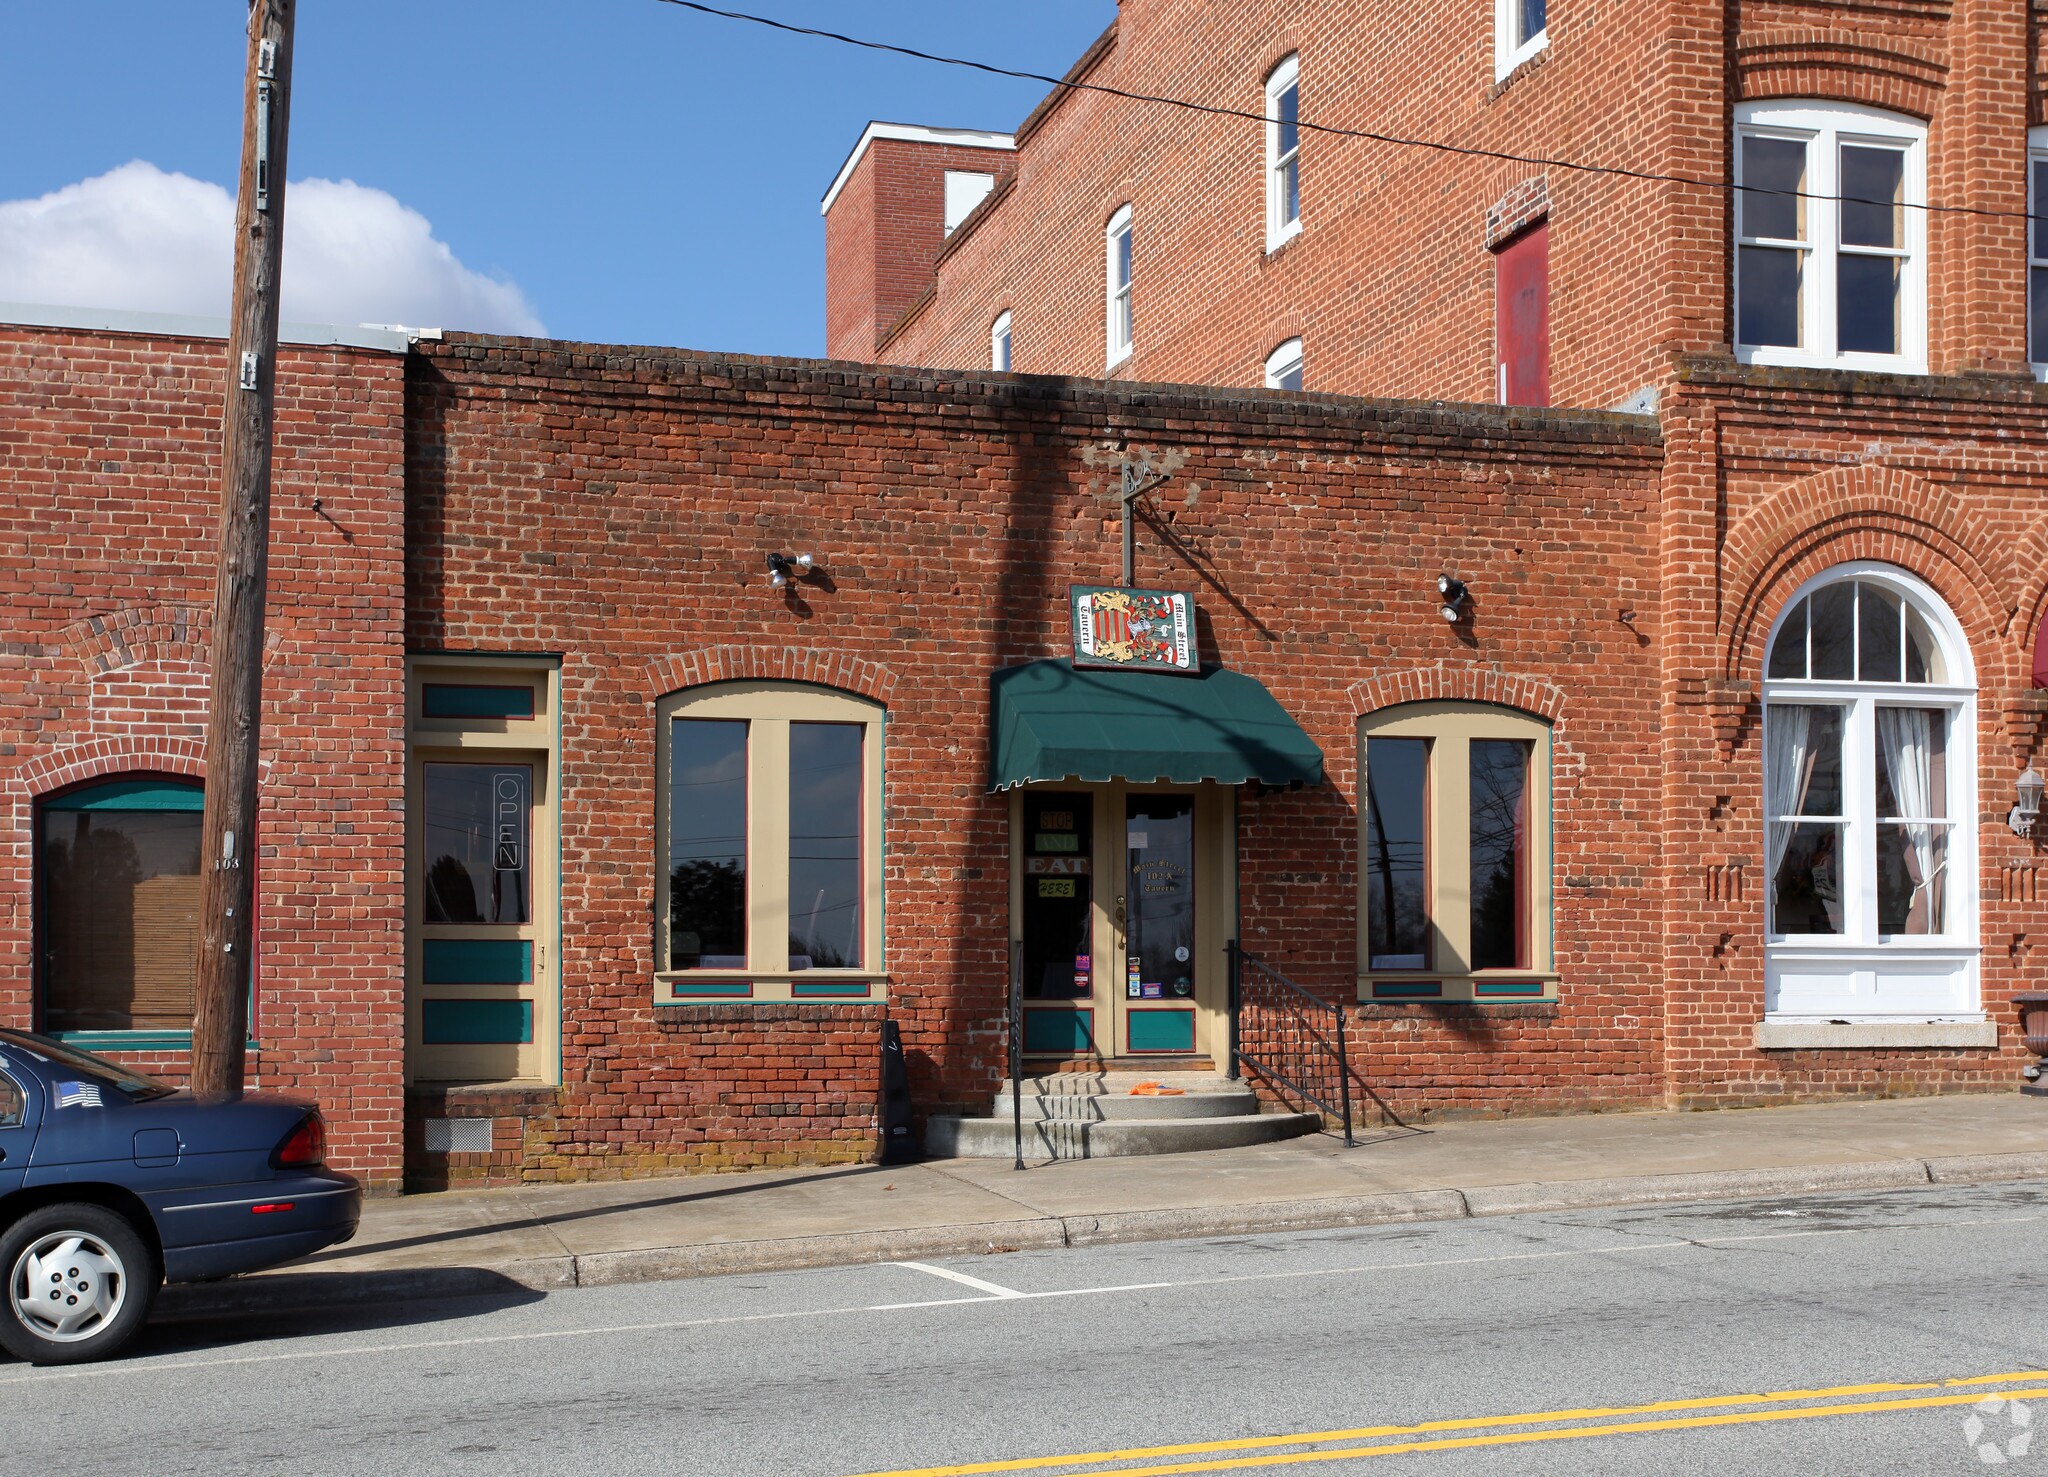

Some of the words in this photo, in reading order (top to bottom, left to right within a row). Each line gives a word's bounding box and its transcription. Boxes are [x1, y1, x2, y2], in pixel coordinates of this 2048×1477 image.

[1174, 603, 1184, 628] Main
[1080, 605, 1091, 645] Tavern
[1177, 631, 1187, 661] Street
[498, 778, 519, 865] OPEN
[1042, 812, 1073, 828] STOP
[1041, 834, 1075, 849] AND
[215, 858, 239, 870] 103
[1028, 858, 1087, 873] EAT
[1133, 862, 1154, 874] Main
[1157, 859, 1186, 874] Street
[1039, 881, 1075, 895] HERE!
[1144, 884, 1175, 892] Tavern
